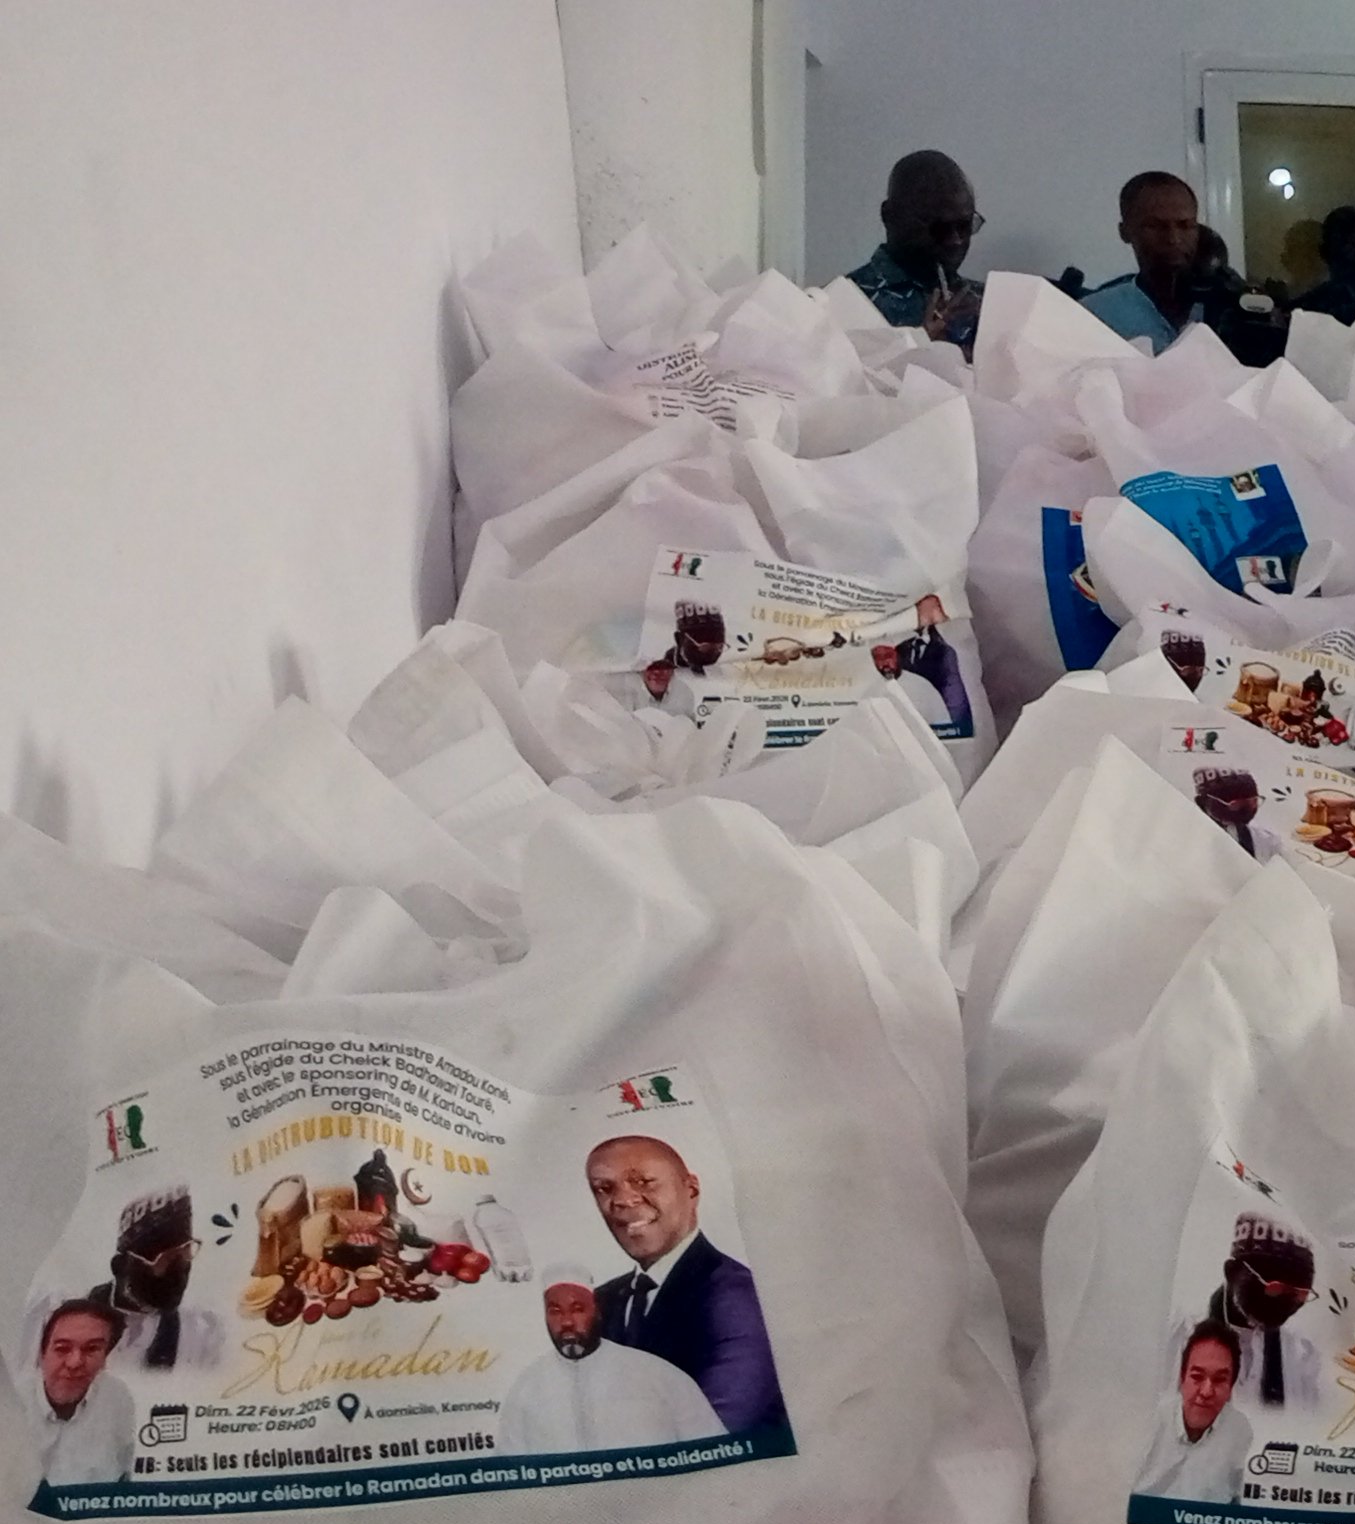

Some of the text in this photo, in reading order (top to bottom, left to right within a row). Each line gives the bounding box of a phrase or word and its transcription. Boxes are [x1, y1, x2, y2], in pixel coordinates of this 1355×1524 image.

[200, 1058, 226, 1079] Sous
[227, 1052, 238, 1066] le
[240, 1039, 335, 1068] parrainage
[341, 1040, 364, 1052] du
[369, 1041, 434, 1065] Ministre
[435, 1056, 480, 1086] Amadou
[219, 1070, 246, 1090] sous
[247, 1054, 294, 1079] l'égide
[300, 1052, 323, 1065] du
[329, 1054, 390, 1067] Cheick
[396, 1056, 458, 1093] Badhawari
[227, 1115, 240, 1129] la
[242, 1087, 305, 1122] Génération
[404, 1101, 419, 1116] de
[422, 1107, 451, 1128] Côte
[454, 1122, 506, 1145] d'Ivoire
[236, 1068, 482, 1125] et avec le sponsoring de M. Kartoun,
[331, 1100, 402, 1122] organise
[233, 1148, 253, 1175] LA
[413, 1137, 433, 1165] DE
[443, 1148, 490, 1175] DON
[221, 1314, 498, 1400] Ramadan
[195, 1404, 232, 1418] Dim.
[236, 1404, 256, 1416] 22
[208, 1417, 316, 1435] Heure: 08H00
[134, 1432, 495, 1474] NB: Seuls les récipiendaires sont conviés
[1303, 1445, 1335, 1458] Dim.
[1339, 1447, 1355, 1458] 22
[58, 1442, 743, 1513] Venez nombreux pour célébrer le Ramadan dans le partage et la solidarité
[1272, 1485, 1312, 1503] Seuls
[1318, 1488, 1340, 1505] les
